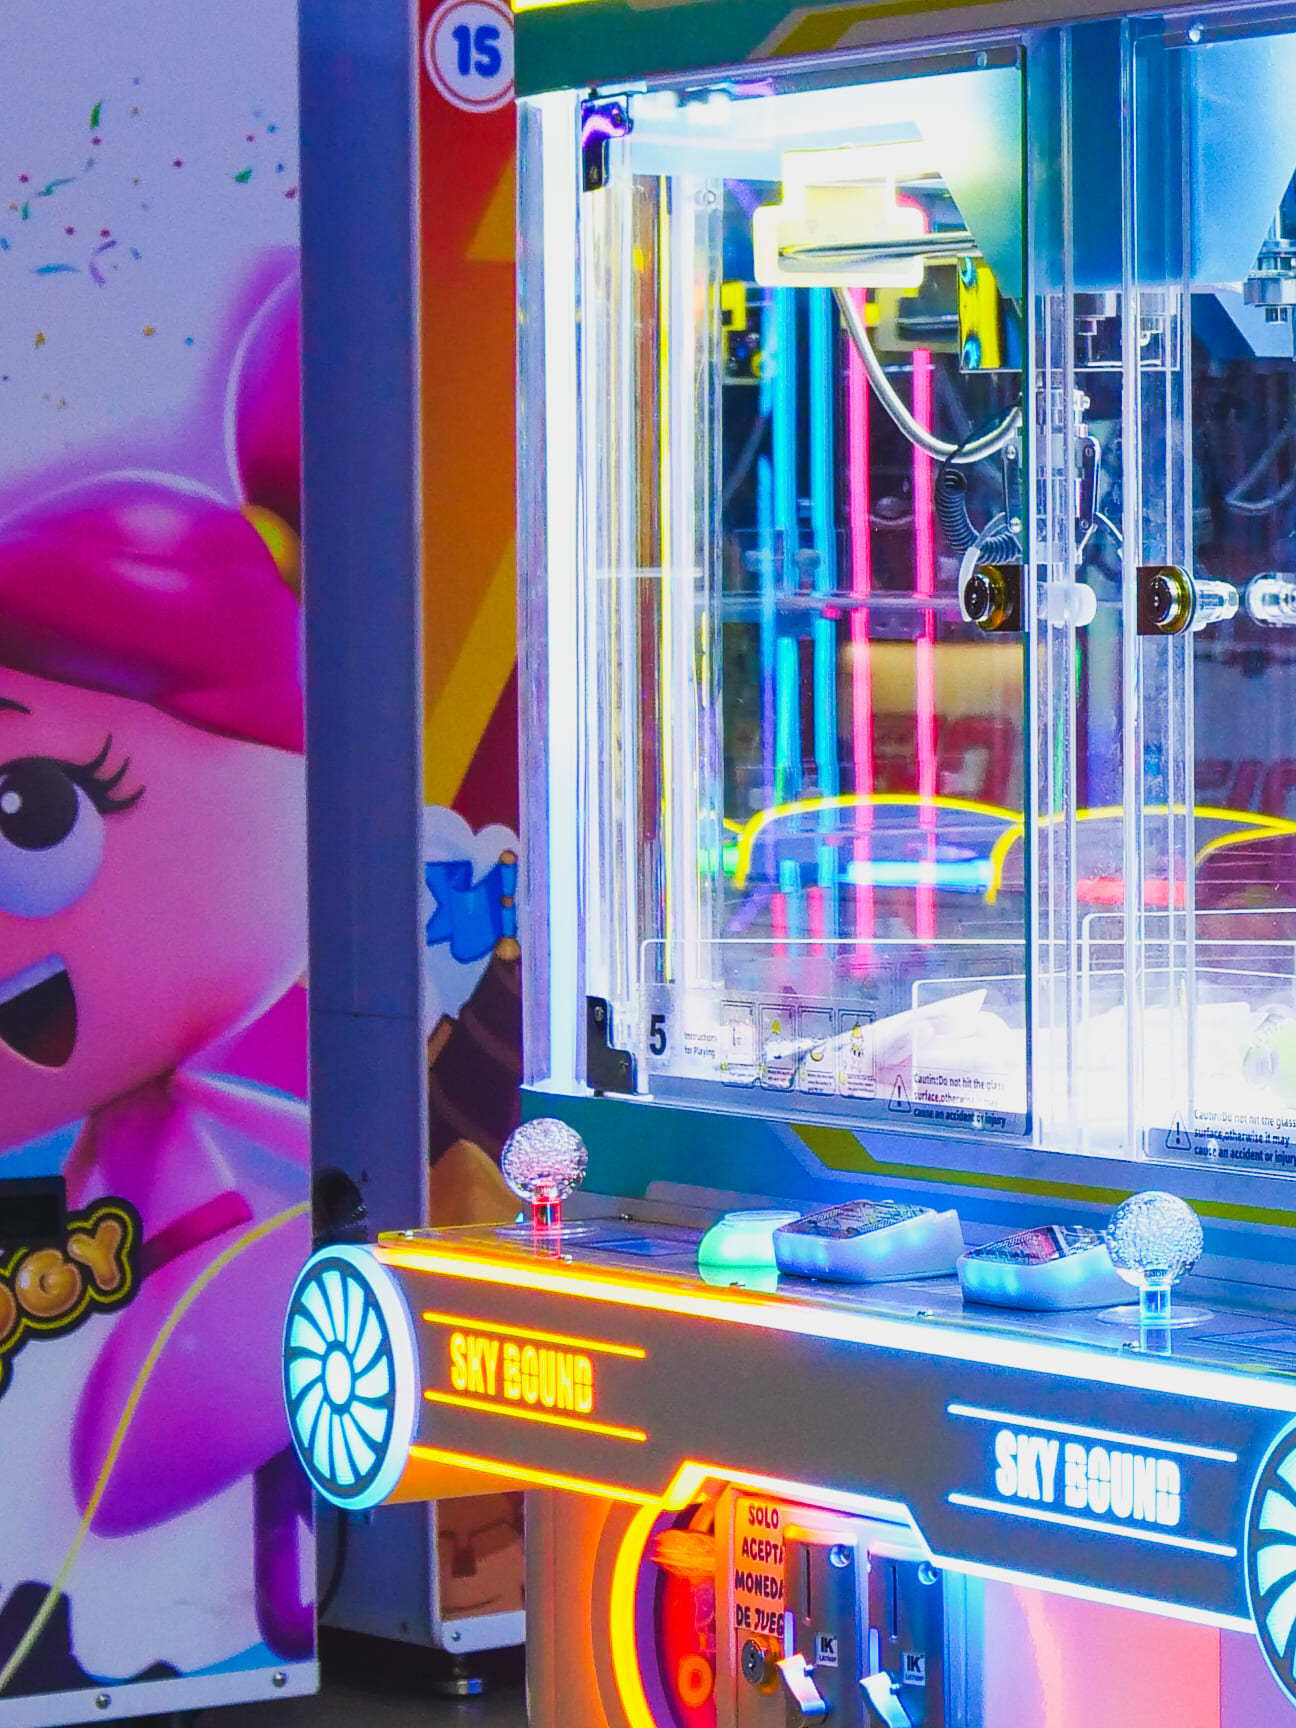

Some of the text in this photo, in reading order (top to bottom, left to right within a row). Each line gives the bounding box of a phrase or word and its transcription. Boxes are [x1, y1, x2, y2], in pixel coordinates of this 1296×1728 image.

[452, 24, 501, 77] 15
[650, 1014, 667, 1056] 5
[1275, 1116, 1296, 1130] glass
[1194, 1145, 1217, 1158] cause
[1218, 1146, 1229, 1159] an
[1230, 1147, 1264, 1162] accident
[1264, 1151, 1273, 1163] or
[1272, 1134, 1290, 1148] may
[0, 1219, 122, 1341] GY
[450, 1331, 595, 1415] SKY BOUND
[995, 1429, 1181, 1528] SKY BOUND
[748, 1505, 779, 1529] SOLO
[735, 1571, 784, 1600] MONEDA
[736, 1604, 784, 1637] DE JUEG
[821, 1636, 834, 1654] IK
[907, 1655, 921, 1673] IK
